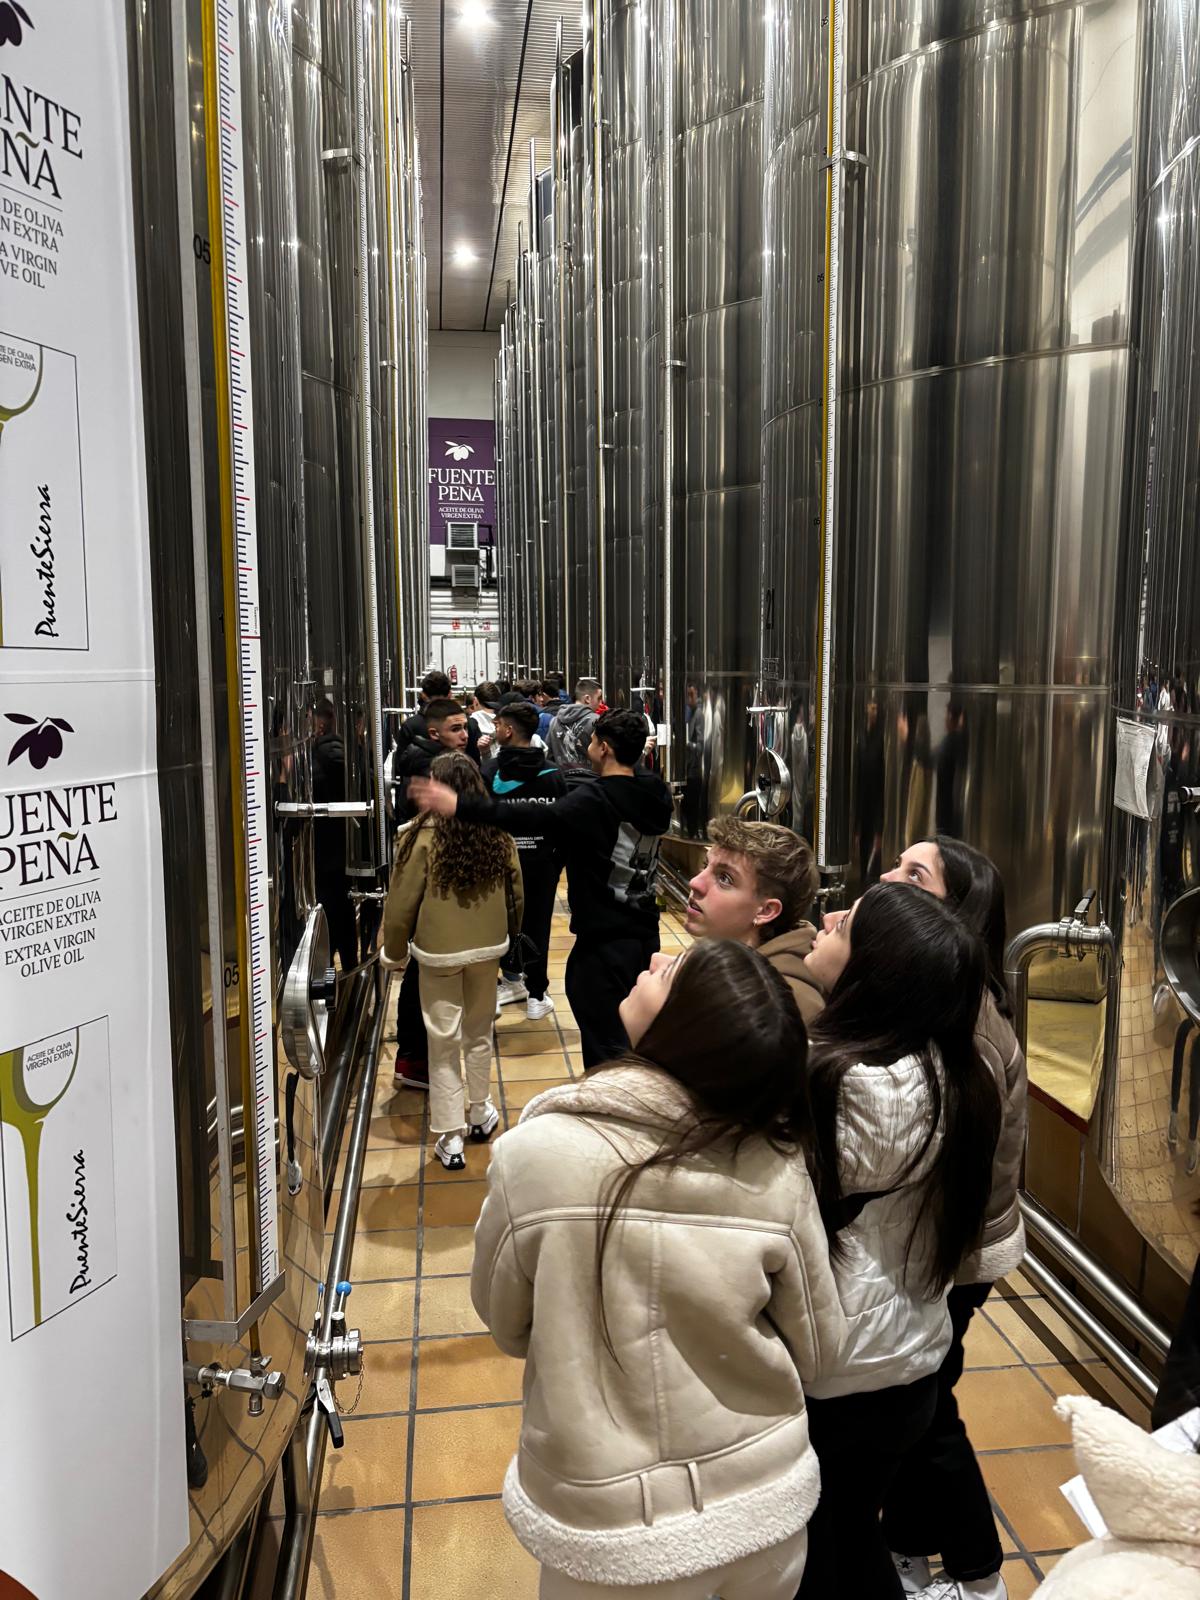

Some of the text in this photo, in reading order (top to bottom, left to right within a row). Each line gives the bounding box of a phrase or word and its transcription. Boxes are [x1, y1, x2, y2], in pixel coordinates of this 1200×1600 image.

[0, 72, 83, 160] NTE
[3, 197, 22, 219] DE
[24, 207, 64, 237] OLIVA
[13, 220, 59, 253] EXTRA
[193, 233, 211, 265] 05
[11, 244, 58, 276] VIRGIN
[22, 267, 45, 289] OIL
[428, 467, 496, 486] FUENTE
[30, 483, 60, 638] PuenteSierra
[46, 898, 64, 916] DE
[65, 889, 102, 910] OLIVA
[0, 907, 97, 942] VIRGEN EXTRA
[4, 927, 96, 965] EXTRA VIRGIN
[20, 948, 85, 978] OLIVE OIL
[223, 964, 240, 988] 05
[25, 1048, 74, 1071] VIRGEN EXTRA
[65, 1149, 92, 1295] PuenteSierra
